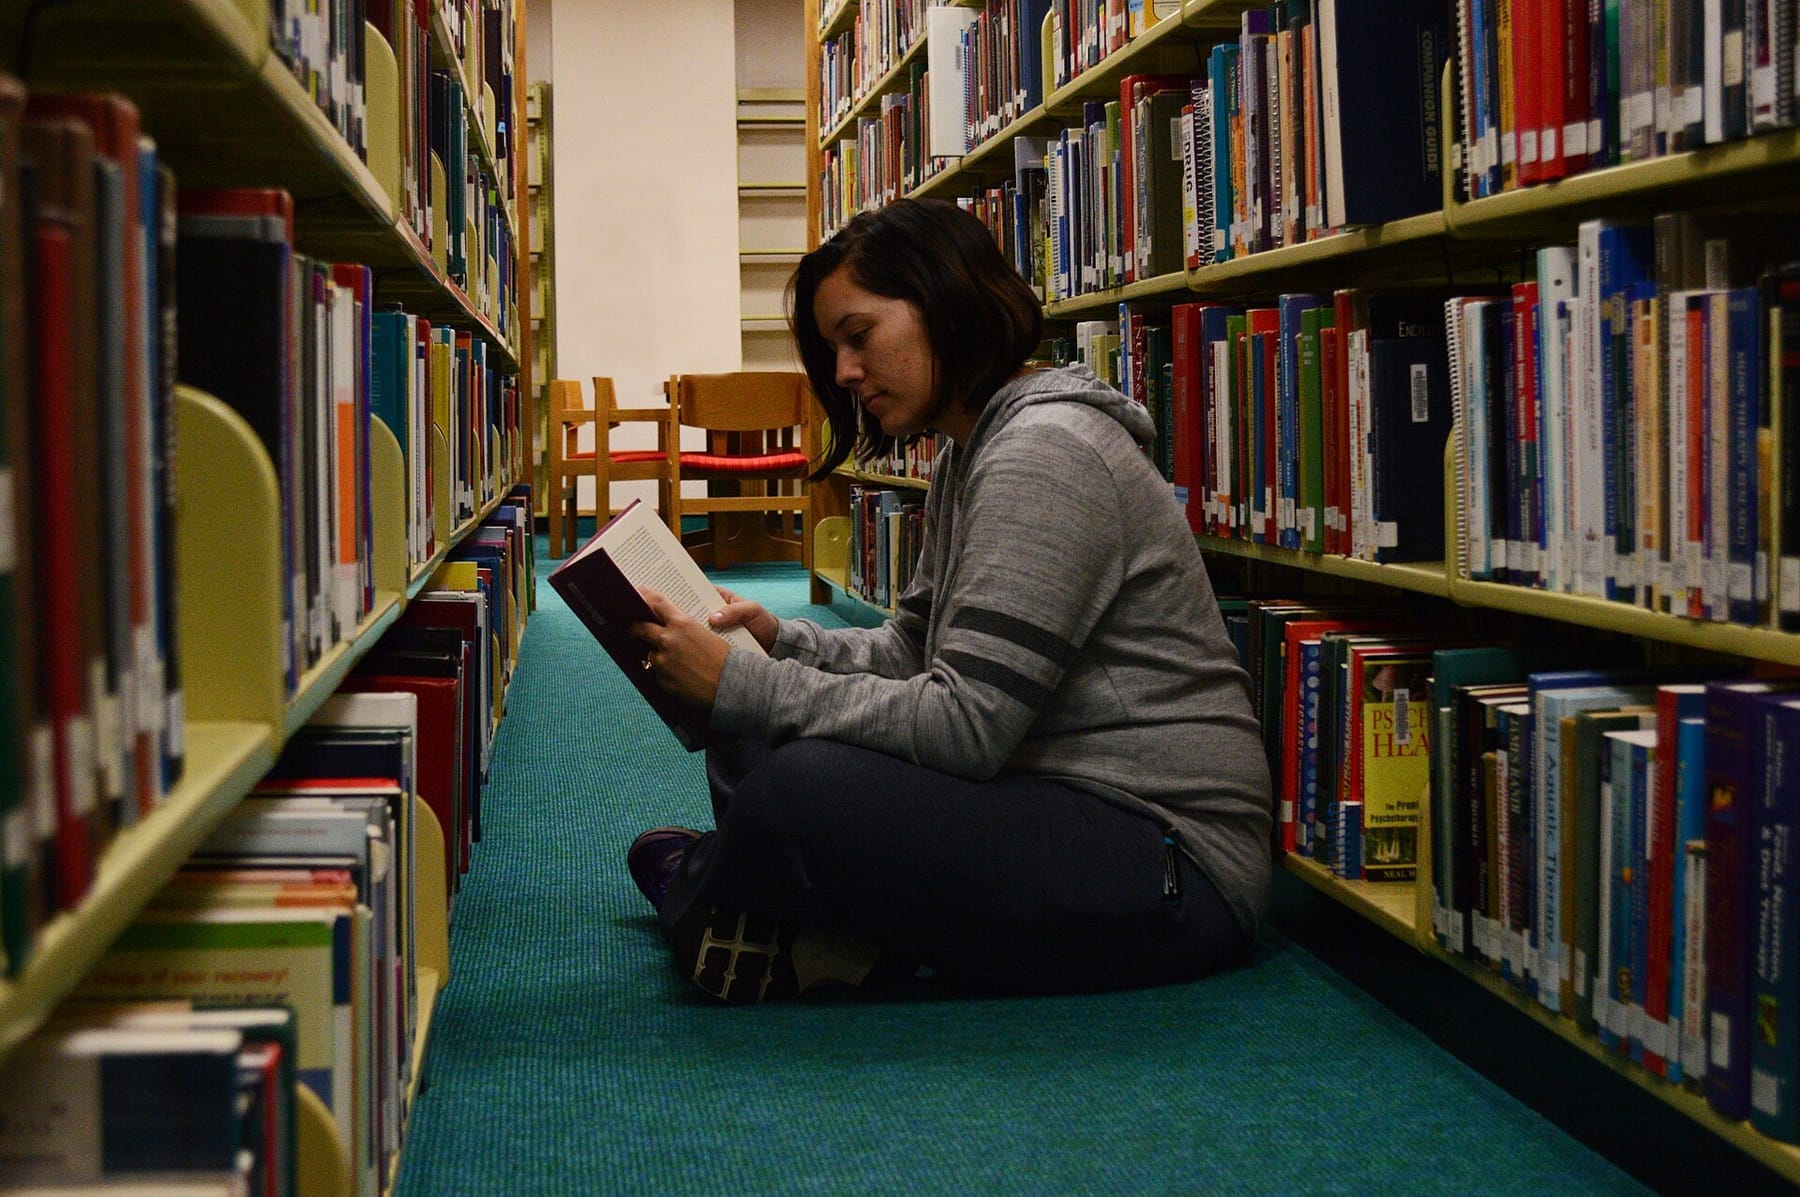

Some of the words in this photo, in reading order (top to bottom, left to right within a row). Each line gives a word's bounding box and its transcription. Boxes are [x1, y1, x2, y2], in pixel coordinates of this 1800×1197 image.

[1421, 30, 1436, 122] COMPANION
[1184, 143, 1192, 193] DRUG
[1425, 125, 1439, 172] GUIDE
[1516, 313, 1525, 362] Professional
[1676, 358, 1684, 377] The
[1735, 351, 1747, 397] MUSIC
[1675, 384, 1684, 446] Handbook
[1735, 401, 1748, 465] THERAPY
[1675, 508, 1685, 556] Therapy
[1735, 471, 1747, 546] RESEARCH
[1373, 707, 1427, 730] PSCH
[1510, 718, 1521, 764] JAMES
[1510, 767, 1522, 815] RANDI
[1547, 755, 1557, 841] Aquatic
[1760, 849, 1772, 890] Diet
[1772, 824, 1786, 880] Food,
[1547, 851, 1558, 944] Therapy
[1757, 899, 1772, 981] Therapy
[1769, 886, 1785, 985] Nutrition,
[213, 967, 289, 985] recovery
